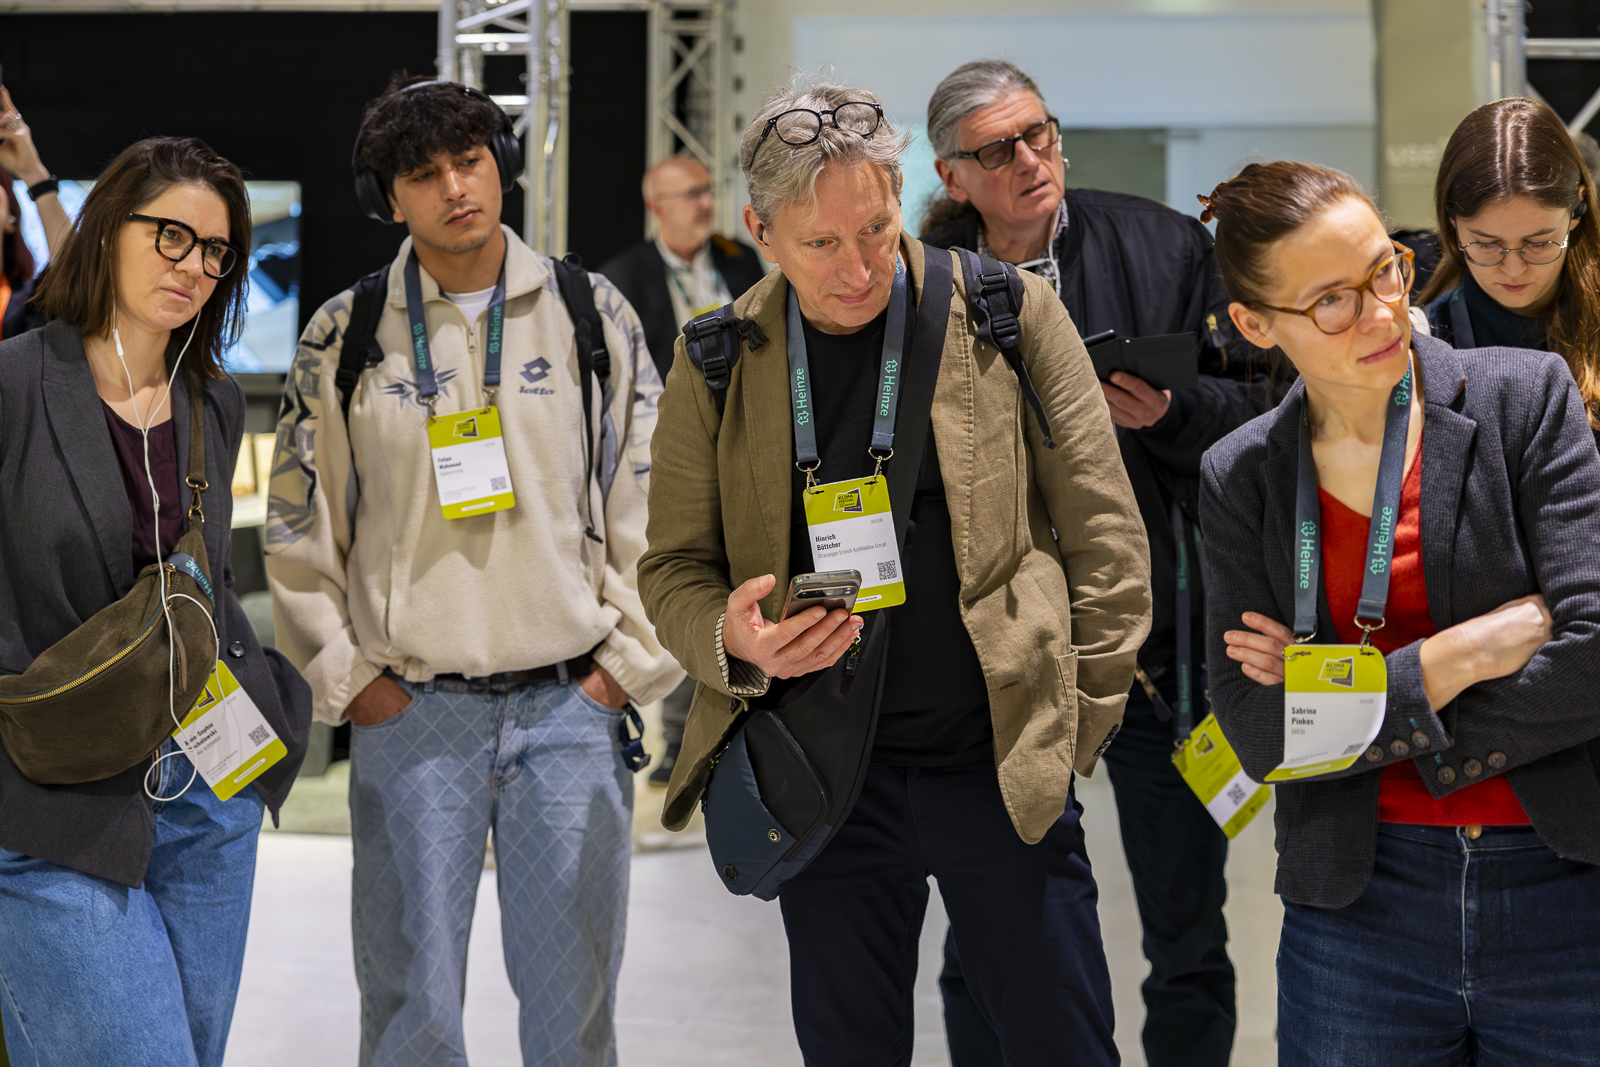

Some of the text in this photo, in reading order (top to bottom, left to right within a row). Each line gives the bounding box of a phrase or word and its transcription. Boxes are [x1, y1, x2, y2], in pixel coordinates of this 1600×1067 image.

[490, 305, 502, 341] Heinze
[415, 336, 427, 370] Heinze
[795, 367, 808, 409] Heinze
[879, 375, 896, 417] Heinze
[815, 533, 837, 543] Hinrich
[816, 542, 841, 551] Böttcher
[1373, 506, 1393, 555] Heinze
[185, 560, 213, 594] Heinze
[1299, 539, 1315, 589] Heinze
[1291, 707, 1317, 715] Sabrina
[1291, 717, 1314, 725] Pinkes
